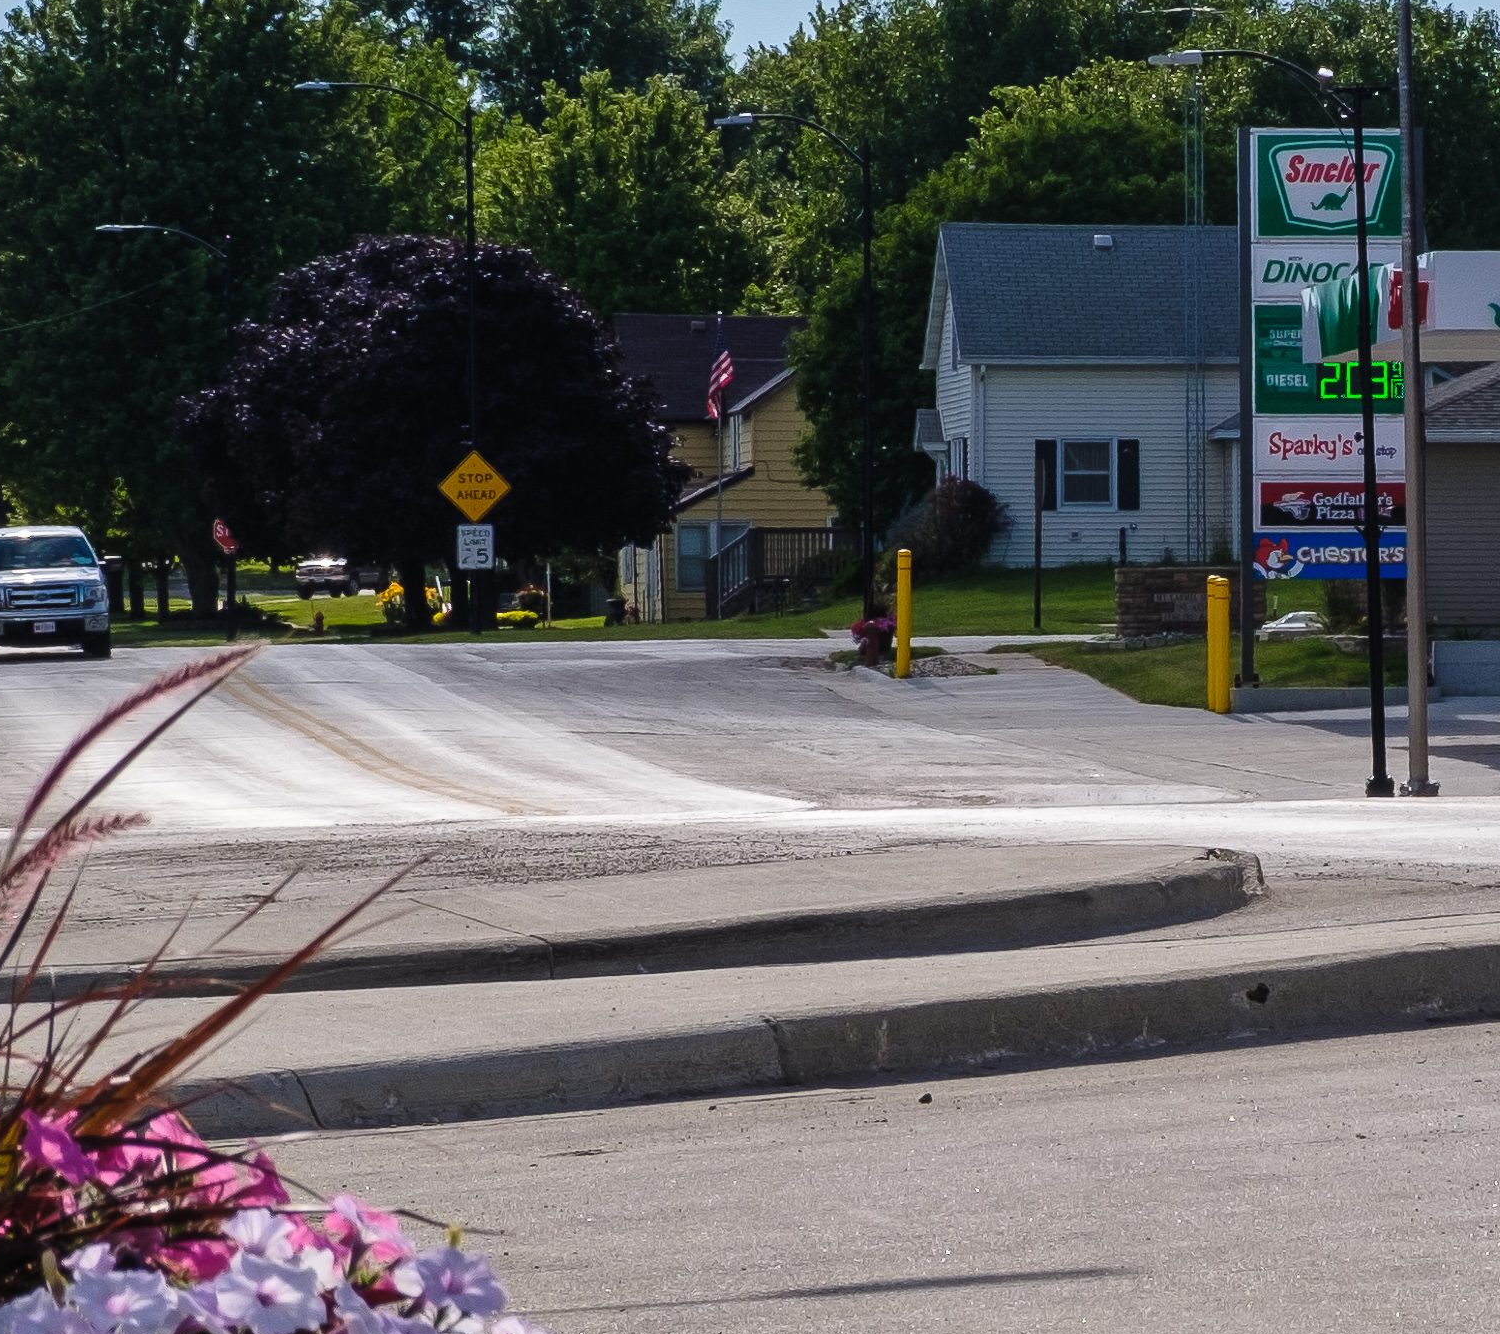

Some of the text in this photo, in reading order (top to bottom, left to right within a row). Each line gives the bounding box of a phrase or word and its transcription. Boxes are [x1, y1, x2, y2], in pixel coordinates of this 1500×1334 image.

[1266, 374, 1308, 387] DIESEL
[1269, 432, 1397, 461] Sparky's stop
[458, 473, 493, 484] STOP
[456, 490, 496, 500] AHEAD
[1317, 506, 1355, 520] Pizza
